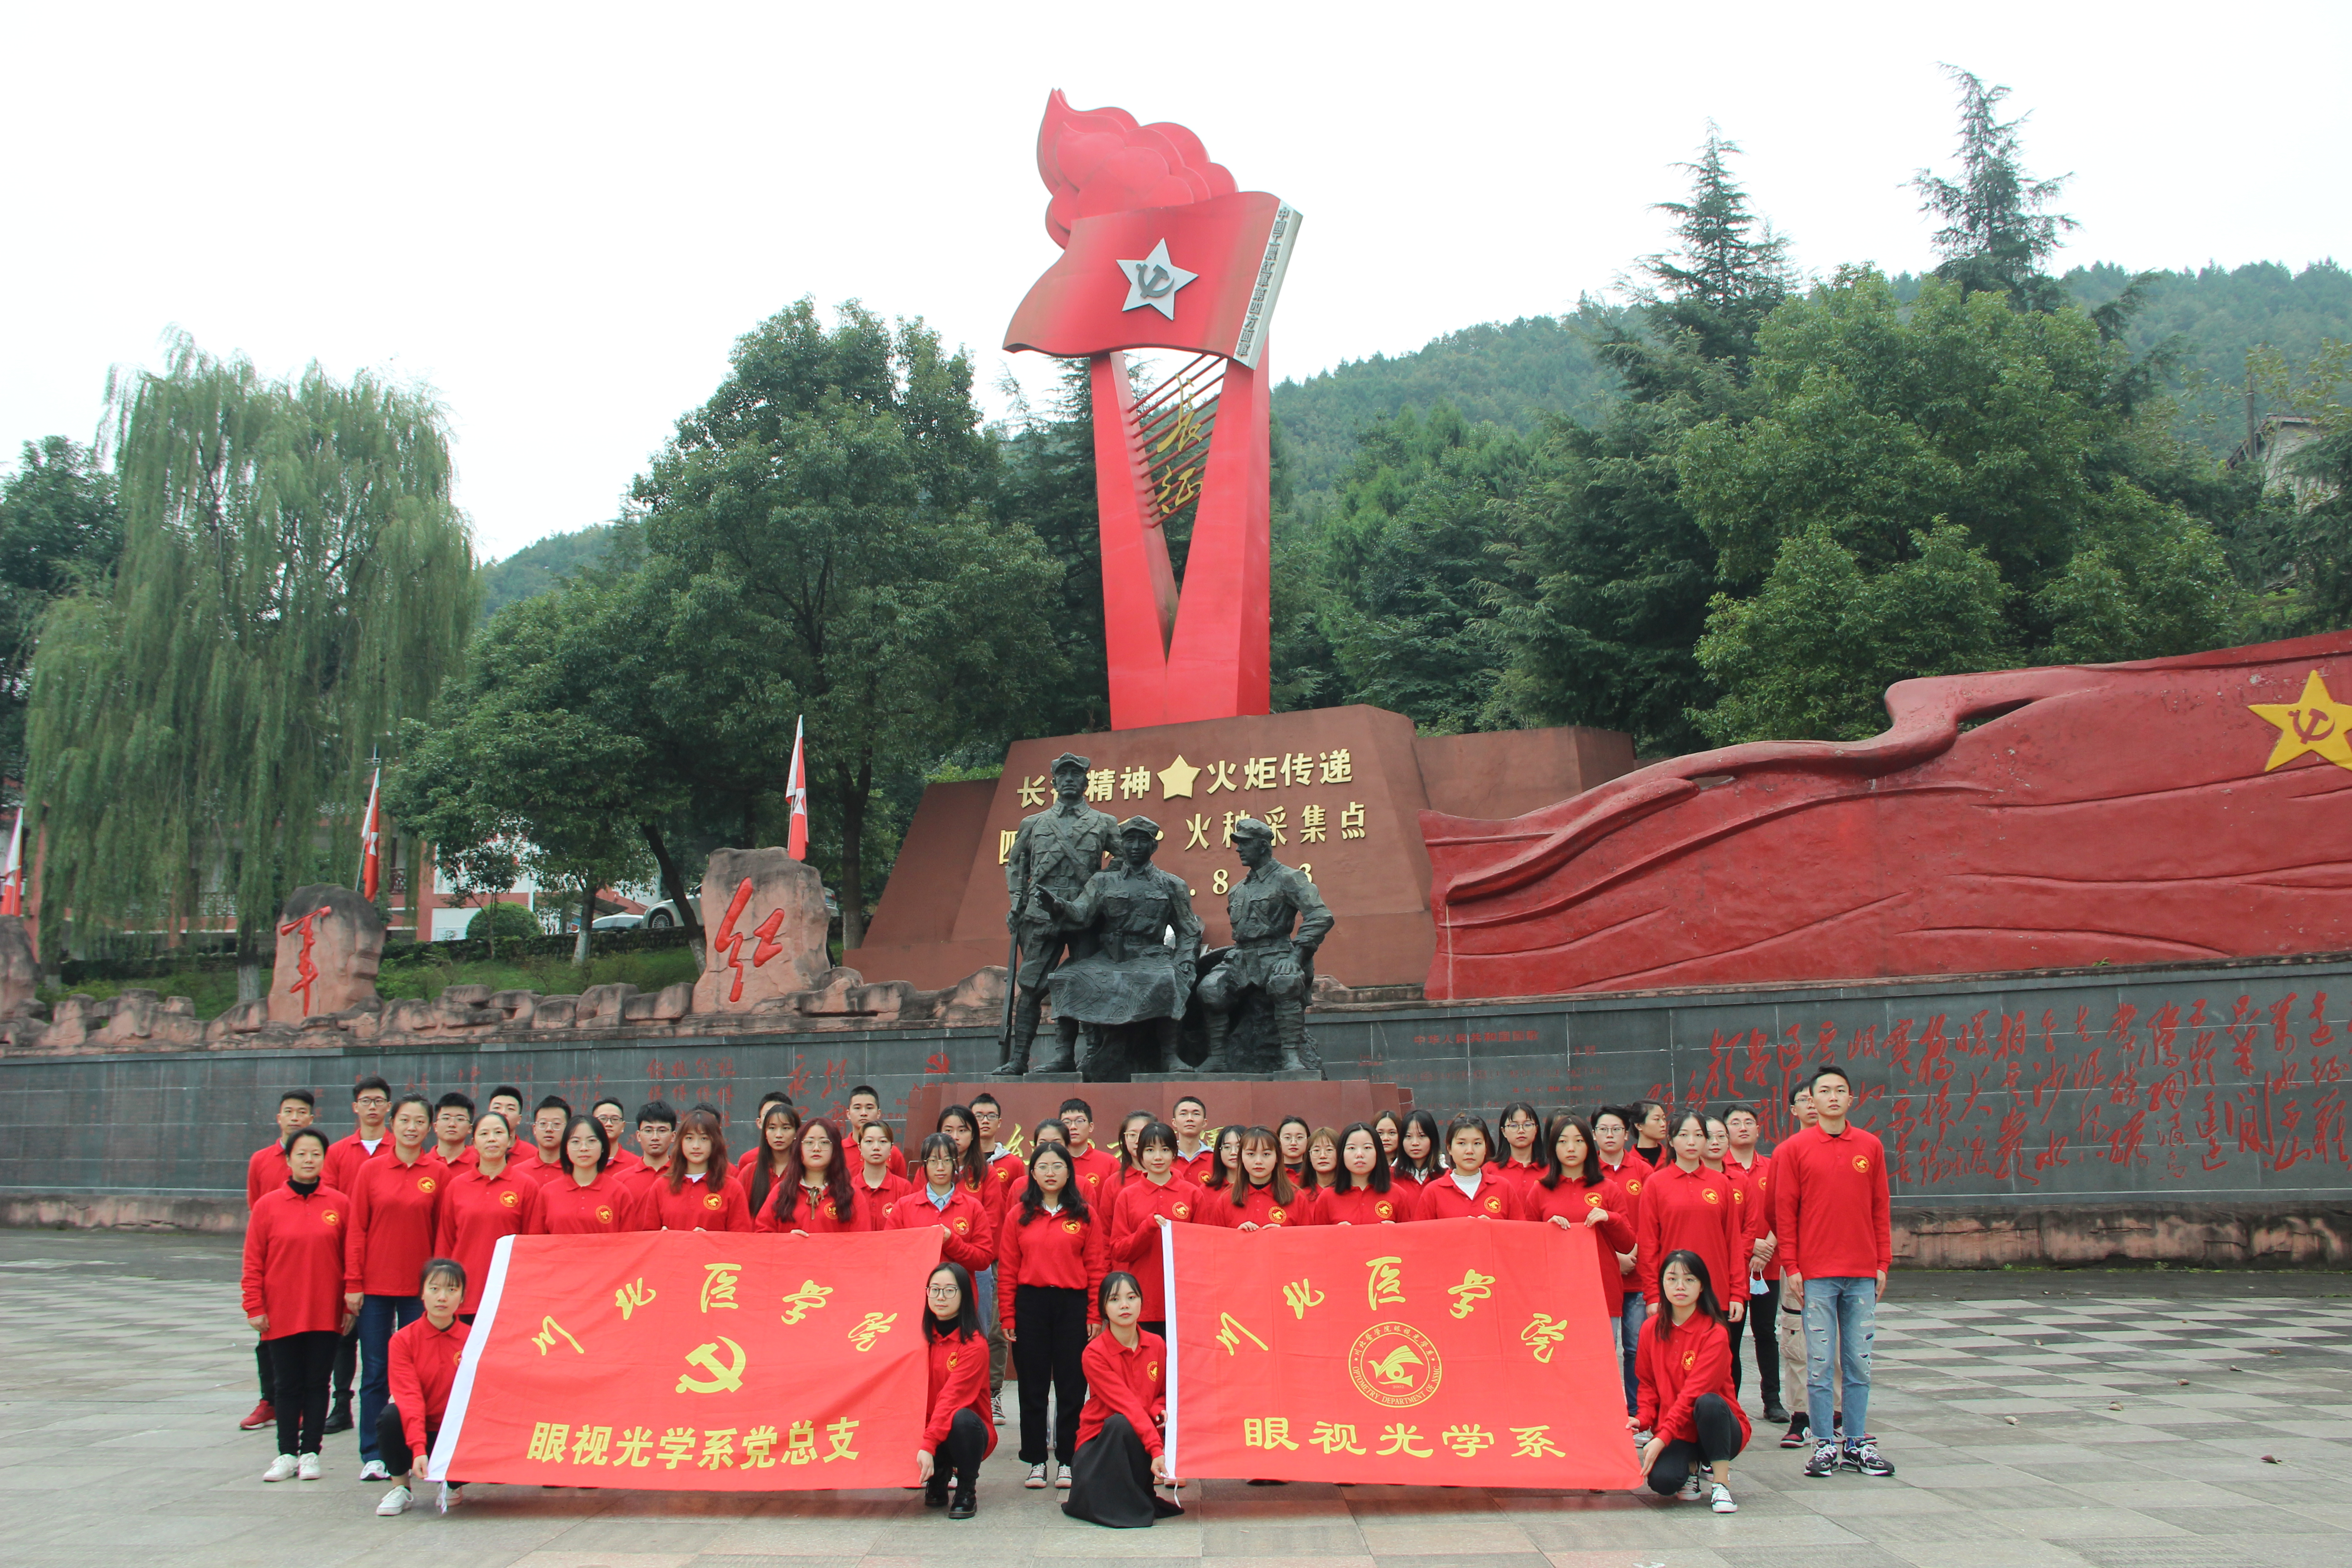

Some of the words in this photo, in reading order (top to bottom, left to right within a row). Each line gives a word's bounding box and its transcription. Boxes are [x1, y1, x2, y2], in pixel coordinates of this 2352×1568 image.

[1017, 766, 1151, 808] 长精神
[1206, 749, 1353, 795] 火炬传递
[532, 1263, 897, 1355] 川北医学院
[1216, 1256, 1568, 1363] 川北医学院
[1352, 1366, 1380, 1400] OPTOMETRY
[1382, 1391, 1426, 1405] DEPARTMENT
[1426, 1384, 1435, 1392] OF
[1431, 1366, 1441, 1384] NSMC
[527, 1416, 860, 1470] 眼视光学系党总支
[1244, 1416, 1566, 1459] 眼视光学系
